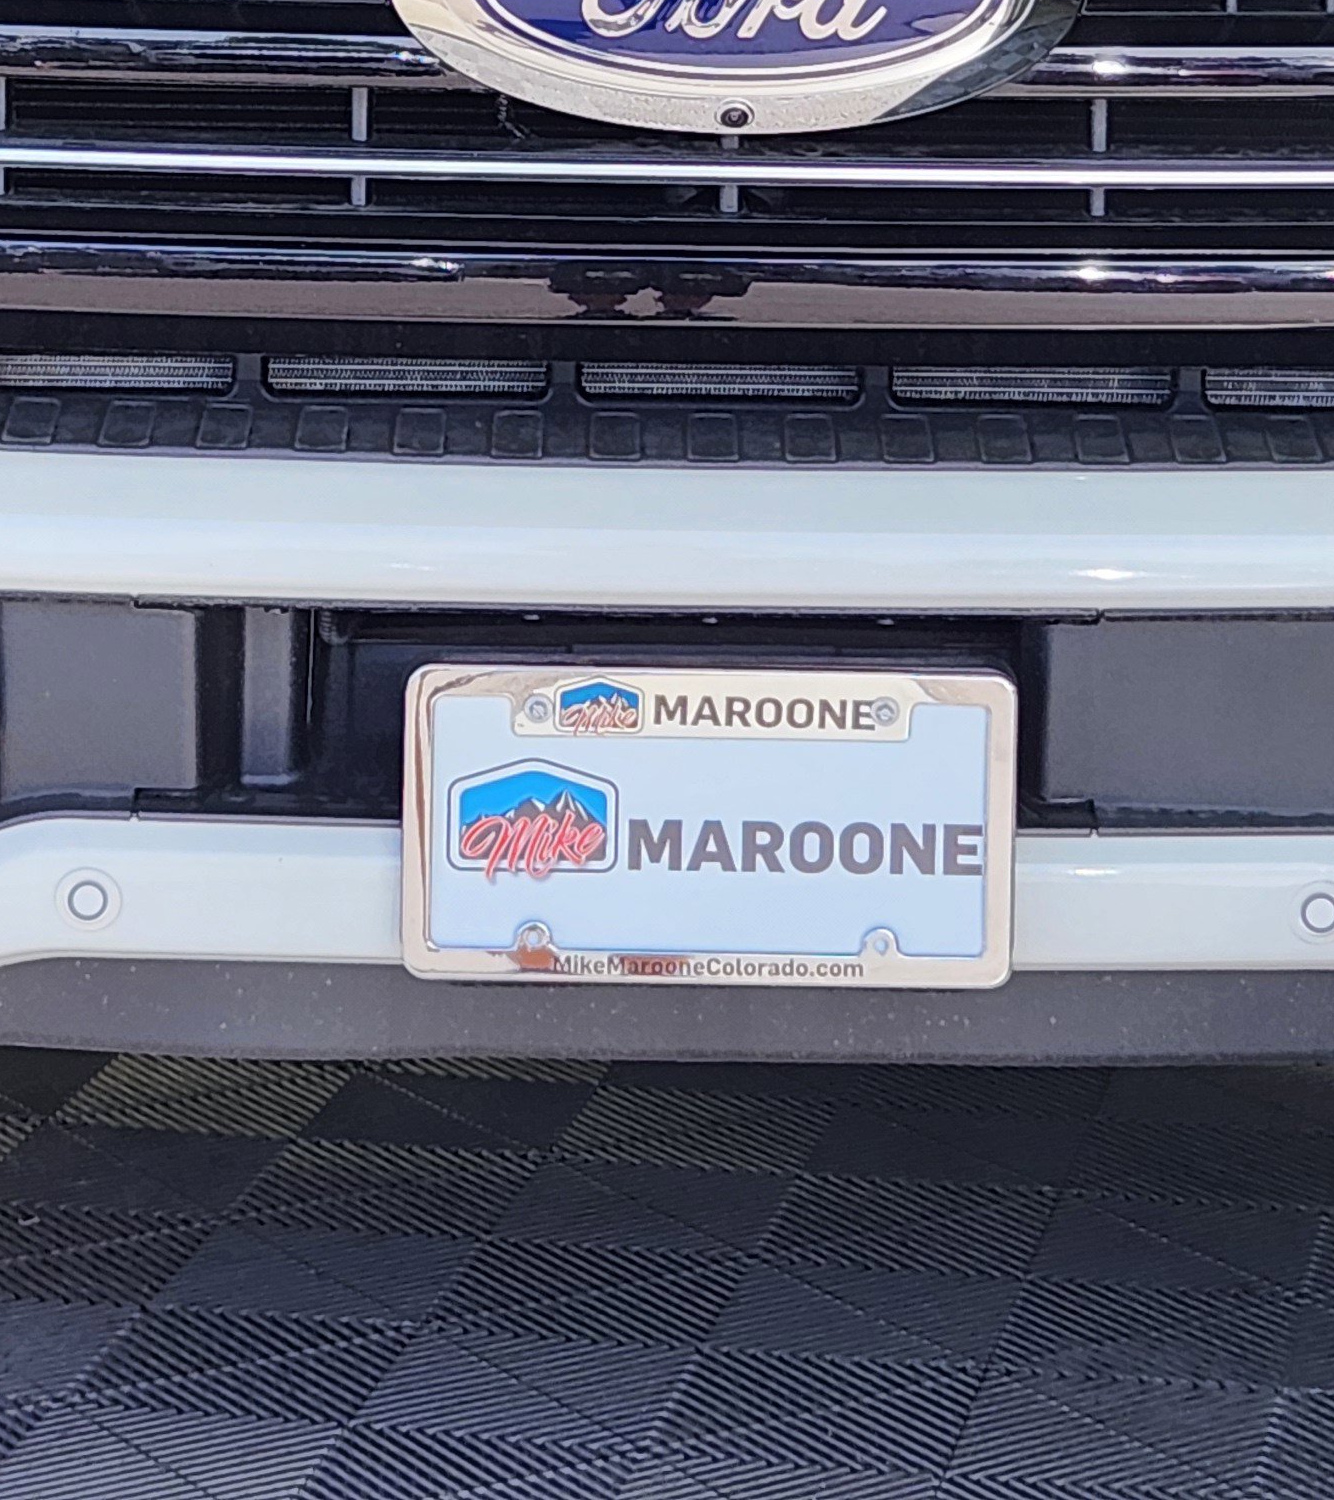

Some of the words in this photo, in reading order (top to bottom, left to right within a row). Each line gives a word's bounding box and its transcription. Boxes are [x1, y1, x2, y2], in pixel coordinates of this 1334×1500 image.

[562, 696, 638, 736] Mike
[653, 694, 877, 731] MAROONE
[460, 810, 605, 883] Mike
[627, 818, 984, 876] MAROONE
[553, 954, 864, 978] MikeMarooneColorado.com
